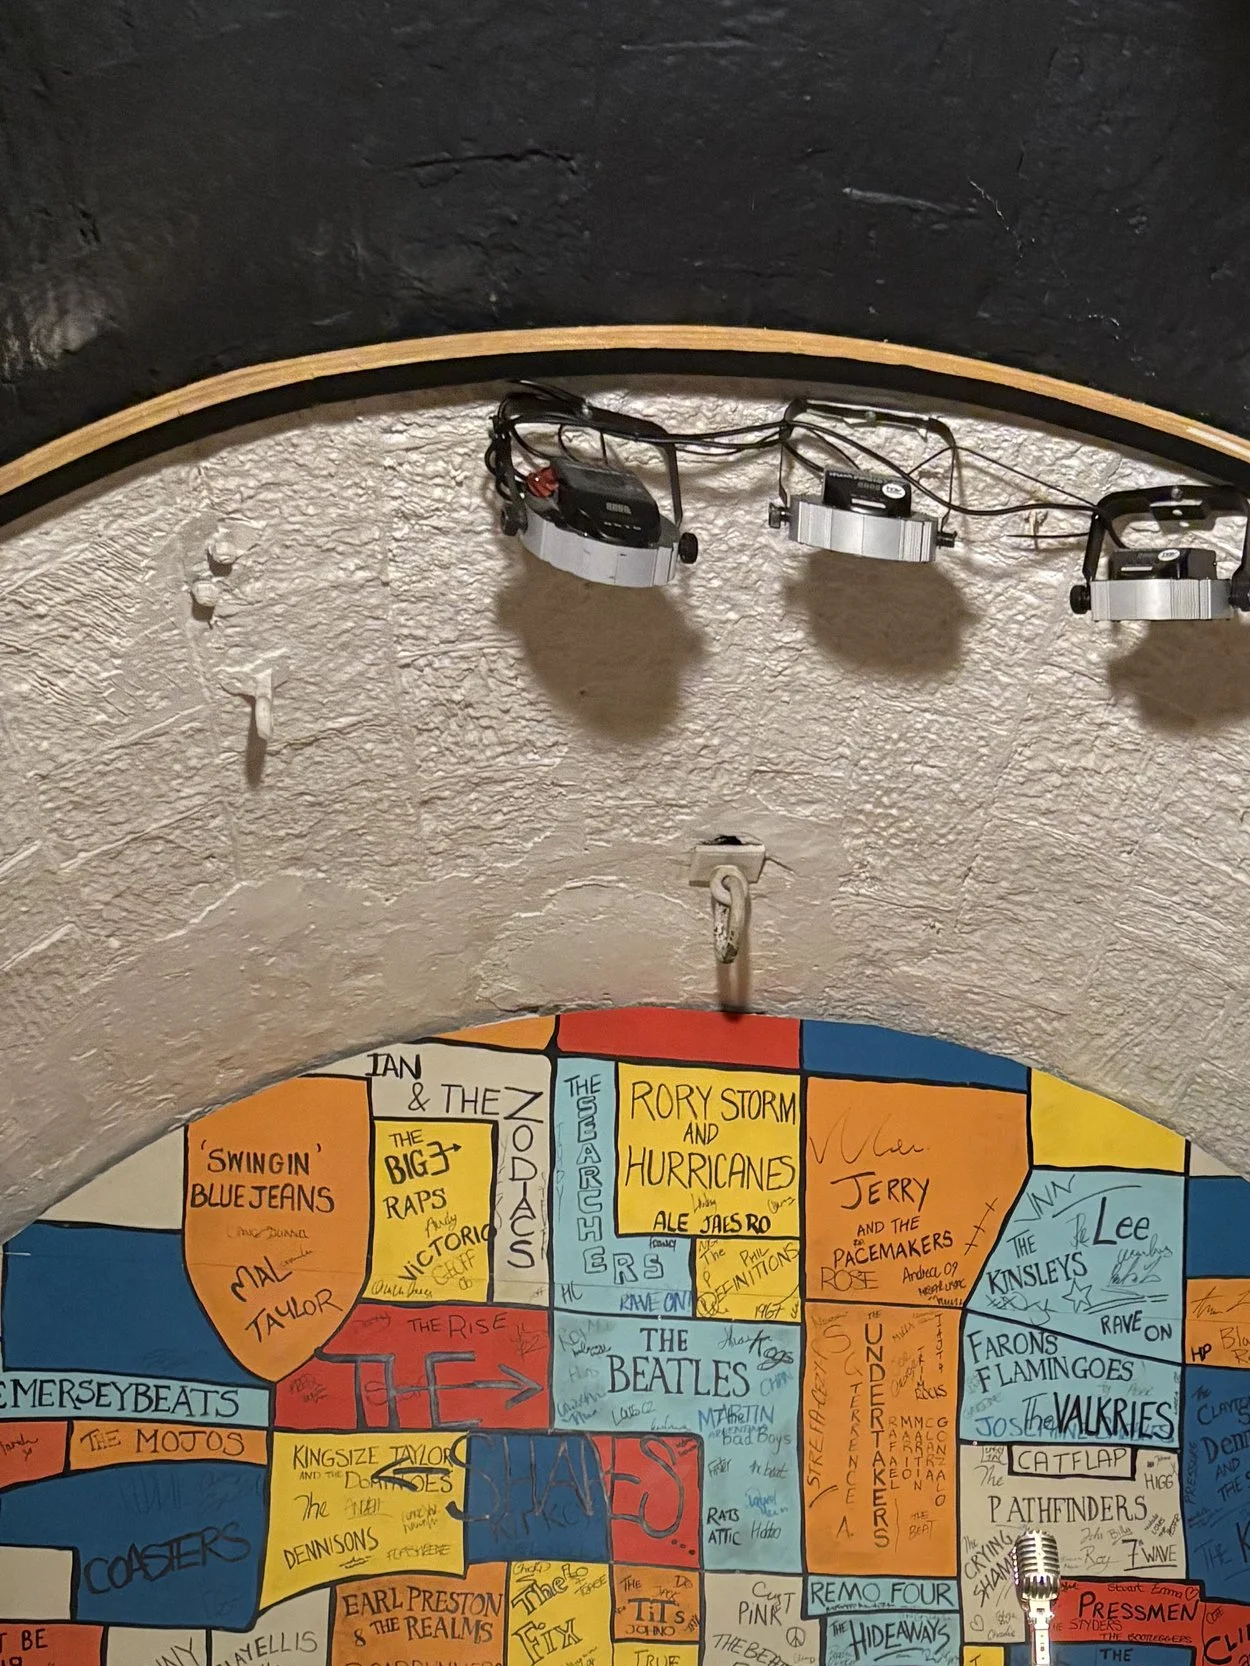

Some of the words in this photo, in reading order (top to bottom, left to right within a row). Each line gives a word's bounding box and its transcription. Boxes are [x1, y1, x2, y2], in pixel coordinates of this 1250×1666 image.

[366, 1053, 422, 1079] IAN
[441, 1084, 500, 1115] THE
[564, 1074, 602, 1097] THE
[630, 1080, 714, 1121] RORY
[720, 1087, 797, 1125] STORM
[389, 1129, 423, 1148] THE
[683, 1123, 719, 1145] AND
[503, 1087, 543, 1268] ZODIACS
[625, 1145, 795, 1191] HURRICANES
[383, 1188, 446, 1219] RAPS
[830, 1172, 929, 1212] JERRY
[653, 1210, 689, 1233] ALE
[857, 1221, 884, 1237] AND
[891, 1215, 920, 1232] THE
[1093, 1196, 1151, 1246] Lee
[834, 1231, 953, 1268] PACEMAKERS
[1006, 1229, 1037, 1259] THE
[986, 1251, 1088, 1296] KINSLEYS
[246, 1289, 343, 1343] TAYLOR
[409, 1318, 441, 1333] THE
[450, 1312, 508, 1339] RISE
[1100, 1310, 1143, 1336] RAVE
[1144, 1323, 1173, 1342] ON
[640, 1328, 689, 1352] THE
[967, 1329, 1059, 1364] FARONS
[607, 1355, 750, 1397] BEATLES
[975, 1356, 1134, 1394] FLAMINGOES
[10, 1379, 239, 1417] MERSEYBEATS
[80, 1428, 121, 1451] THE
[136, 1429, 245, 1456] MOJOS
[864, 1323, 890, 1548] UNDERTAKERS
[900, 1416, 913, 1480] MARIO
[294, 1445, 379, 1470] KINGSIZE
[1018, 1448, 1127, 1473] CATFLAP
[1215, 1458, 1241, 1481] AND
[974, 1465, 1005, 1487] The
[1216, 1478, 1244, 1503] THE
[294, 1492, 329, 1521] The
[987, 1494, 1149, 1523] PATHFINDERS
[84, 1522, 250, 1595] COASTERS
[284, 1527, 379, 1569] DENNISONS
[964, 1530, 1013, 1581] CRYING
[512, 1575, 568, 1616] The
[619, 1575, 641, 1592] THE
[811, 1581, 880, 1604] REMO
[891, 1581, 954, 1607] FOUR
[343, 1591, 405, 1617] EARL
[406, 1585, 503, 1618] PRESTON
[1078, 1591, 1199, 1622] PRESSMEN
[22, 1629, 48, 1650] BE
[370, 1616, 400, 1636] THE
[403, 1616, 493, 1644] REALMS
[712, 1633, 746, 1656] THE
[829, 1620, 848, 1637] THE
[849, 1619, 950, 1662] HIDEAWAYS
[1099, 1648, 1133, 1662] THE
